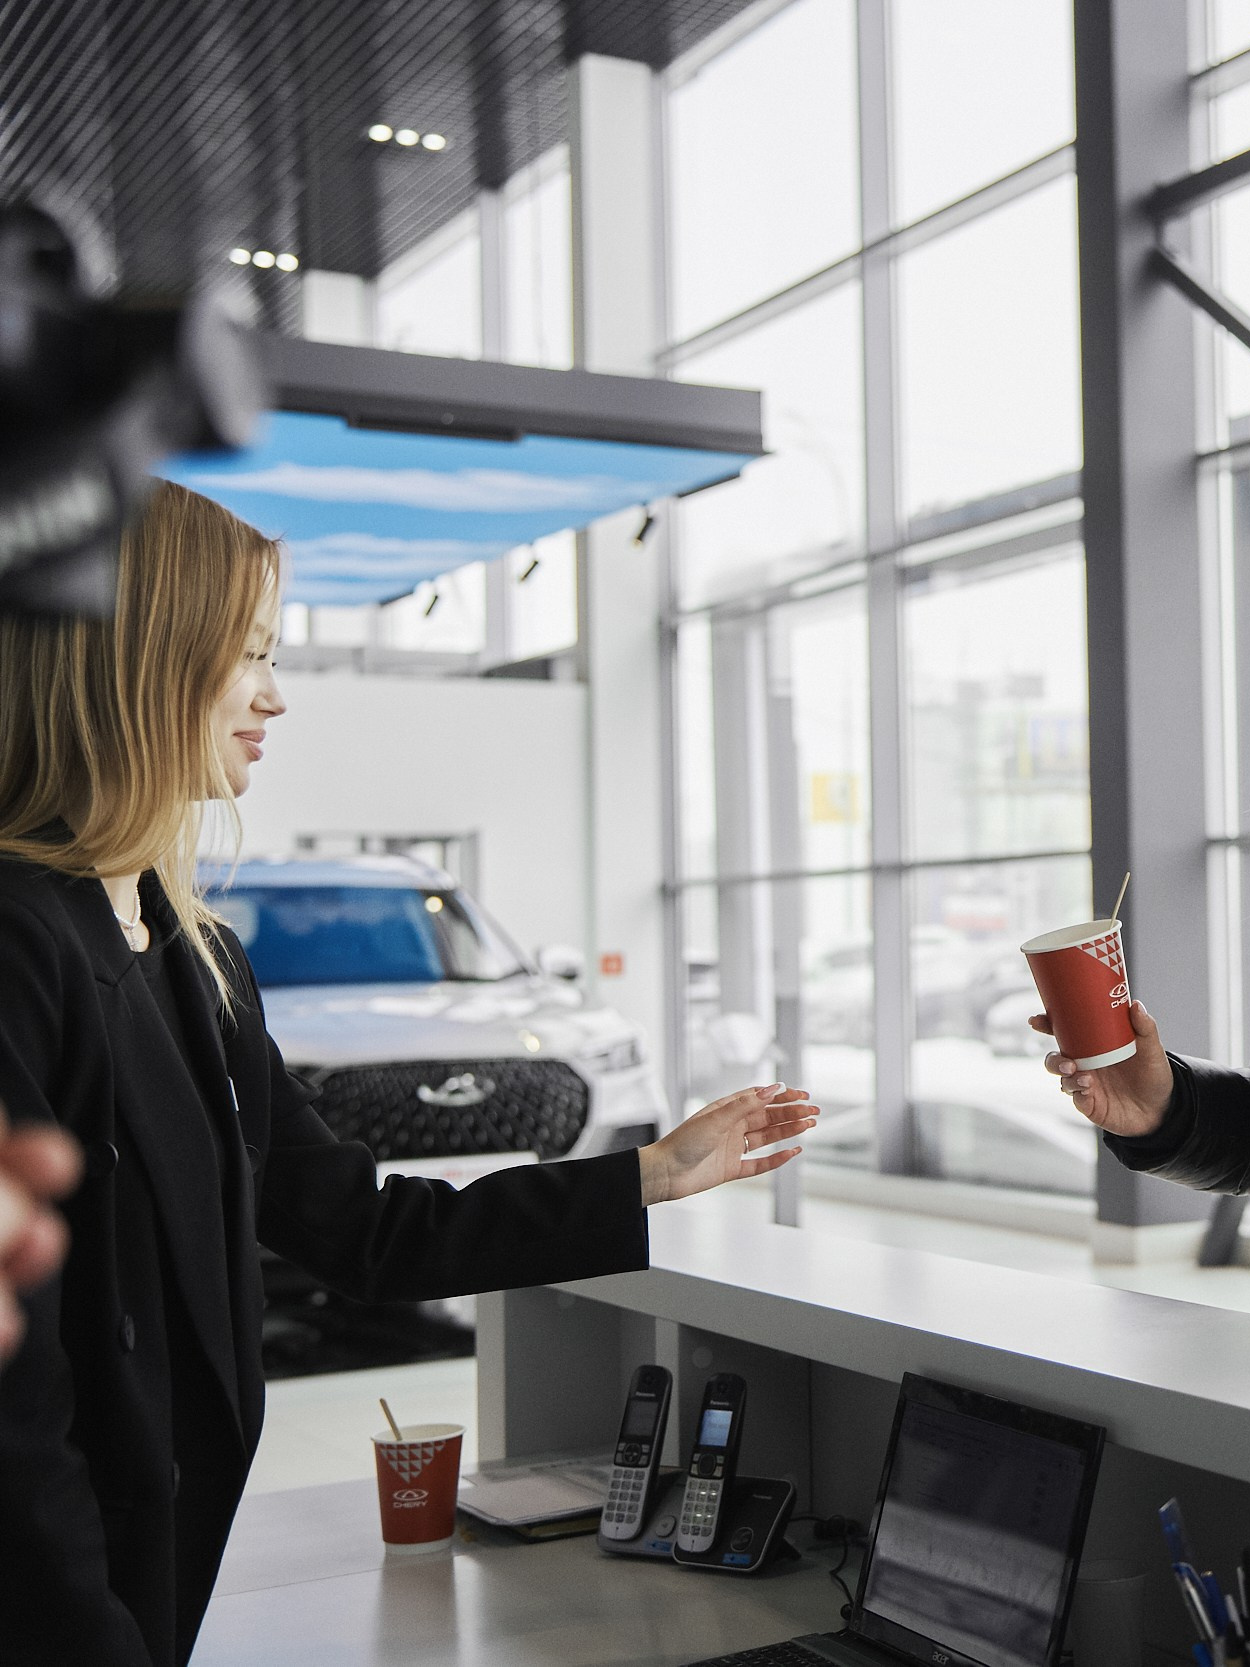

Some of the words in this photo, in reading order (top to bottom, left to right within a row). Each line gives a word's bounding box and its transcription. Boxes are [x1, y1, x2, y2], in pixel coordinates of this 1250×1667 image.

[1111, 995, 1130, 1009] CHE
[393, 1500, 428, 1509] CHERY
[932, 1651, 949, 1665] acer
